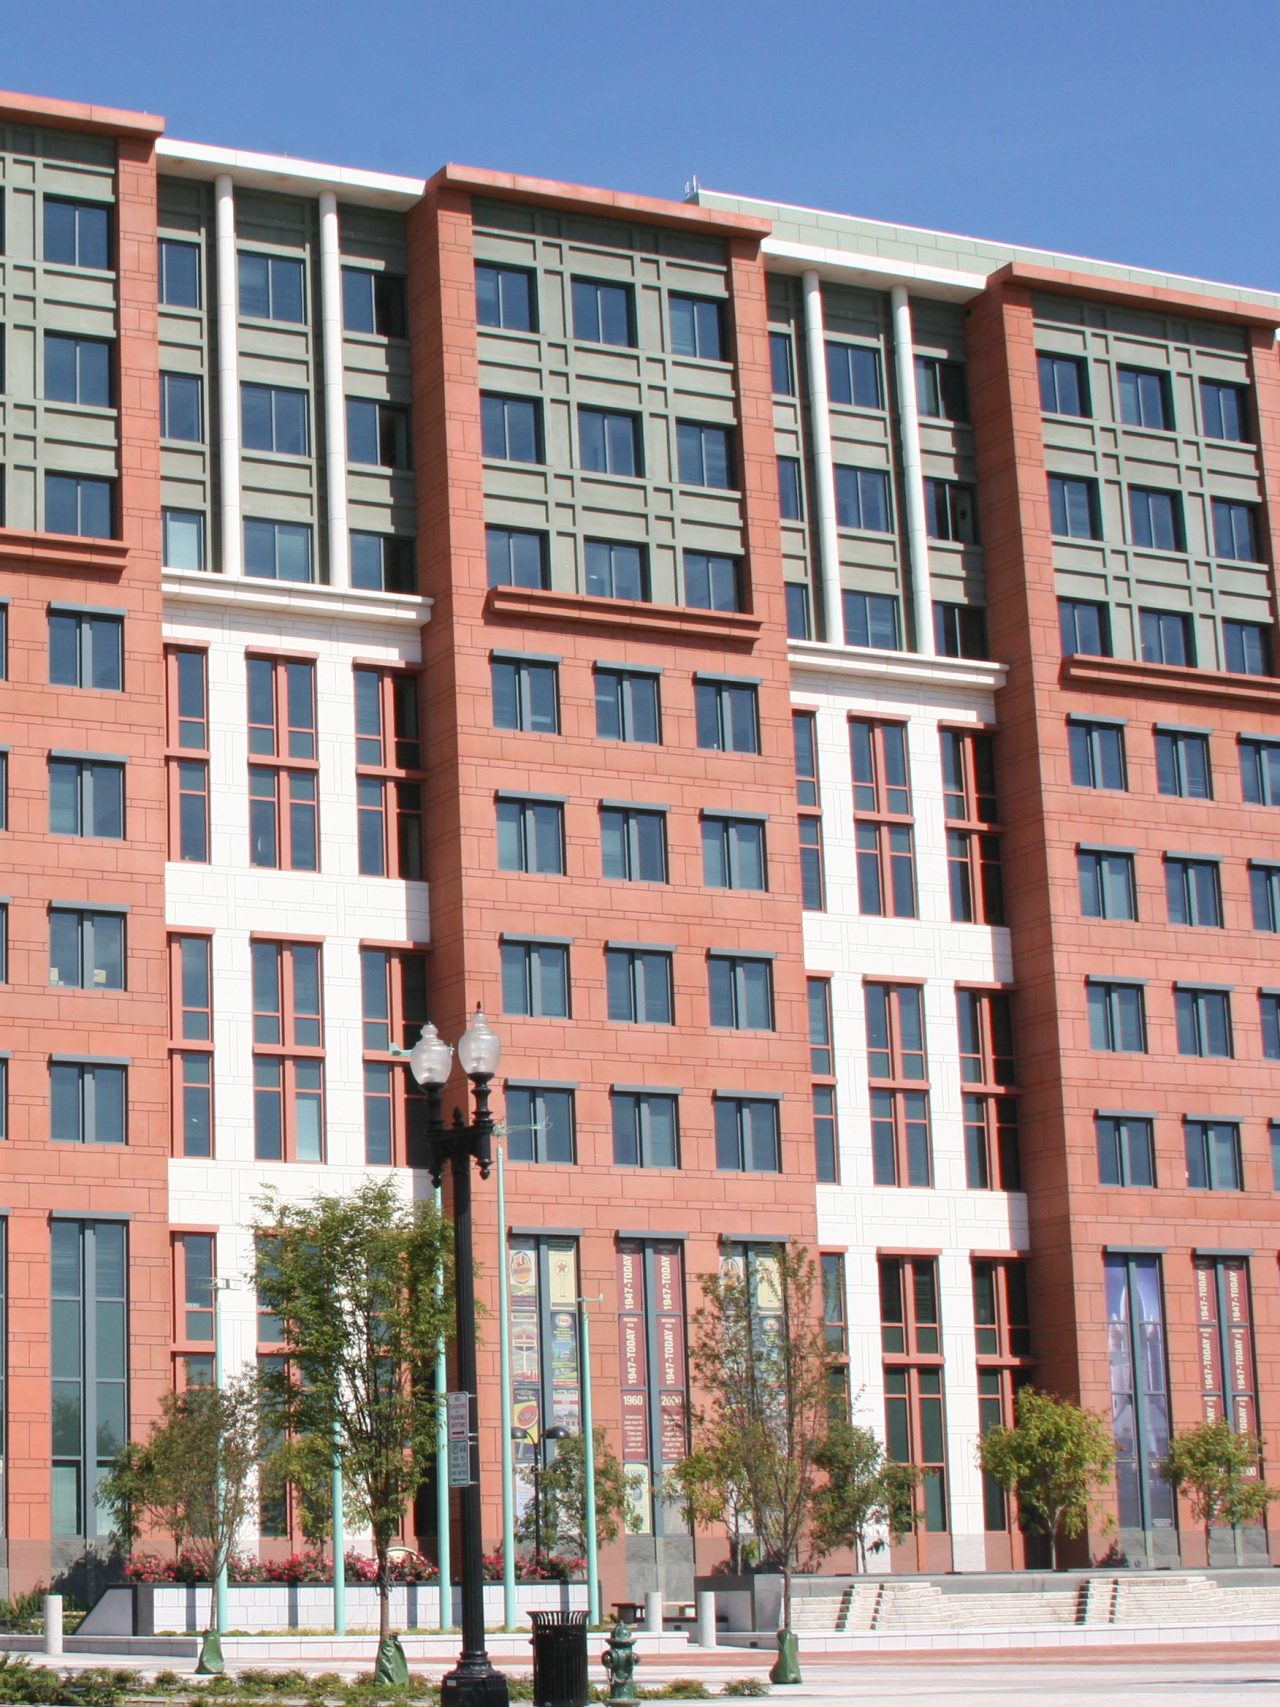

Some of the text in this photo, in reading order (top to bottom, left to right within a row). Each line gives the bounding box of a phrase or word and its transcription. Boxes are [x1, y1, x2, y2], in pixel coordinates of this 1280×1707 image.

[622, 1254, 635, 1310] 1947-TODAY
[660, 1255, 672, 1310] 1947-TODAY
[1197, 1270, 1209, 1321] 1947-TODAY
[1228, 1271, 1241, 1322] 1947-TODAY
[625, 1328, 637, 1385] 1947-TODAY
[663, 1329, 675, 1385] 1947-TODAY
[1201, 1338, 1214, 1390] 1947-TODAY
[1234, 1339, 1246, 1390] 1947-TODAY
[623, 1394, 643, 1406] 1960
